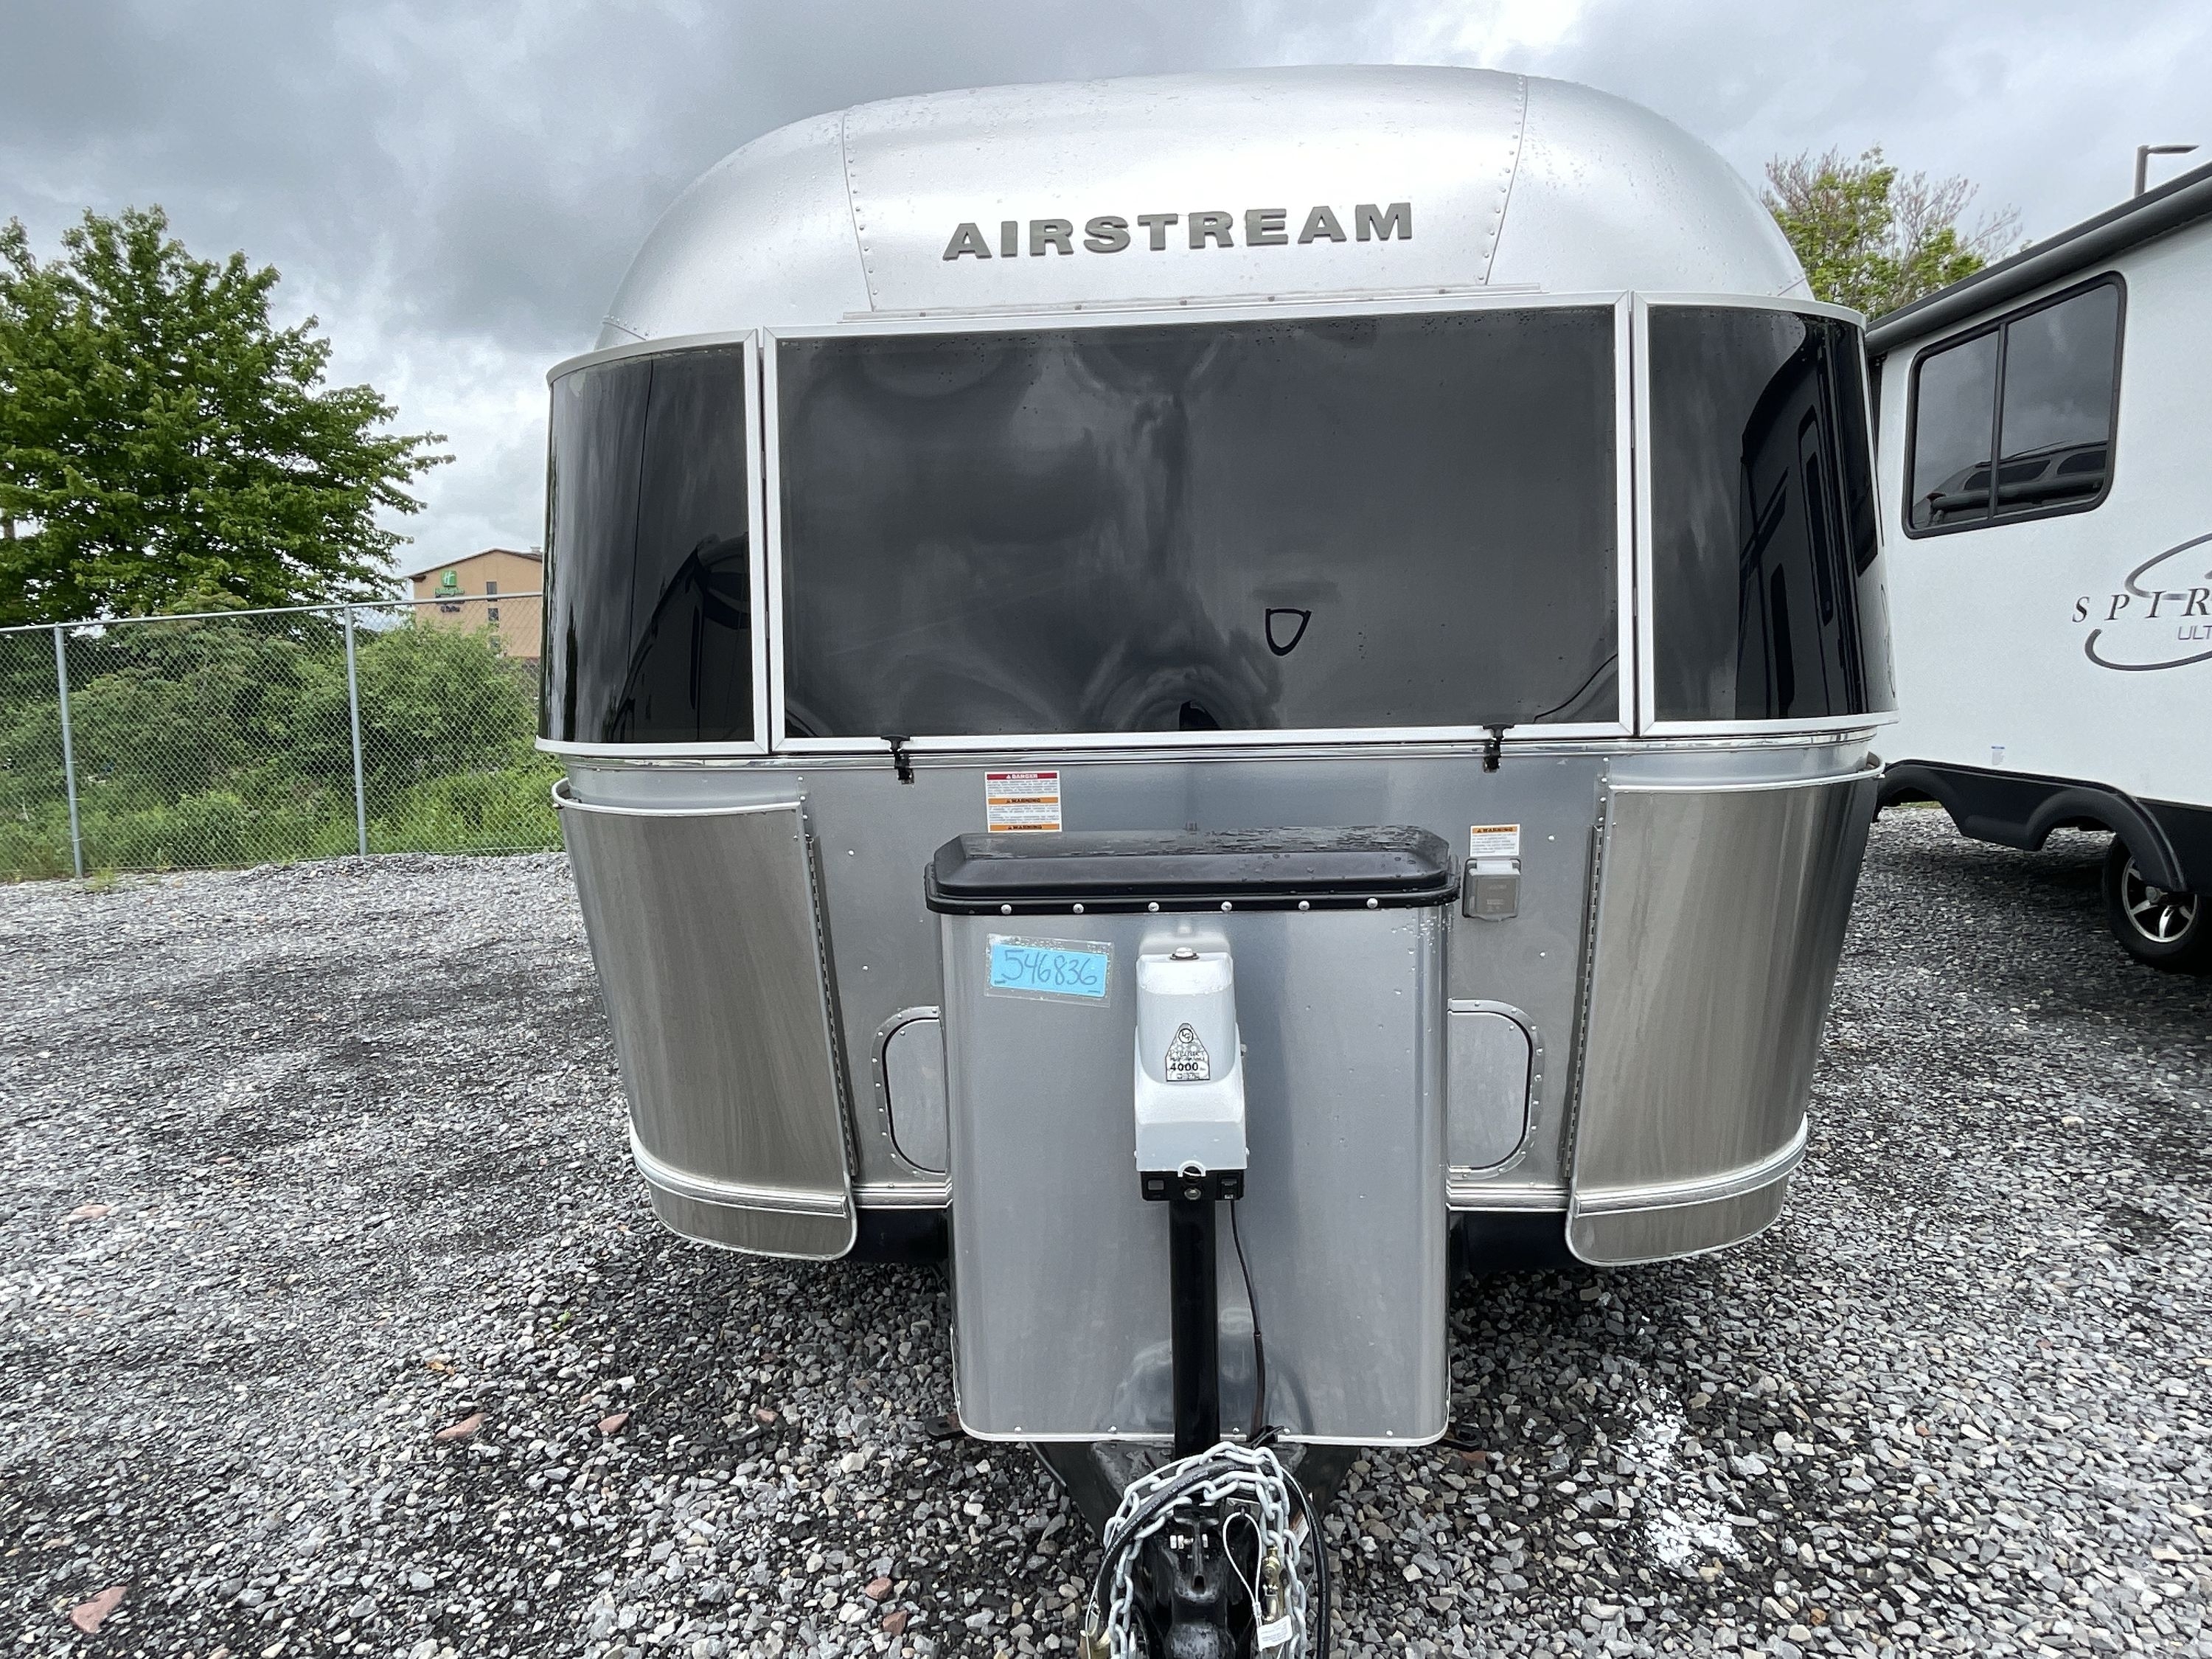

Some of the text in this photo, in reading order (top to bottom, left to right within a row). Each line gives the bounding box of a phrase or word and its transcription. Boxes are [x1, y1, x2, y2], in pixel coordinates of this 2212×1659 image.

[942, 202, 1413, 261] AIRSTREAM
[2072, 588, 2212, 622] SPIR
[2178, 625, 2212, 640] ULT
[1001, 949, 1097, 986] 546836
[1169, 1062, 1198, 1071] 4000
